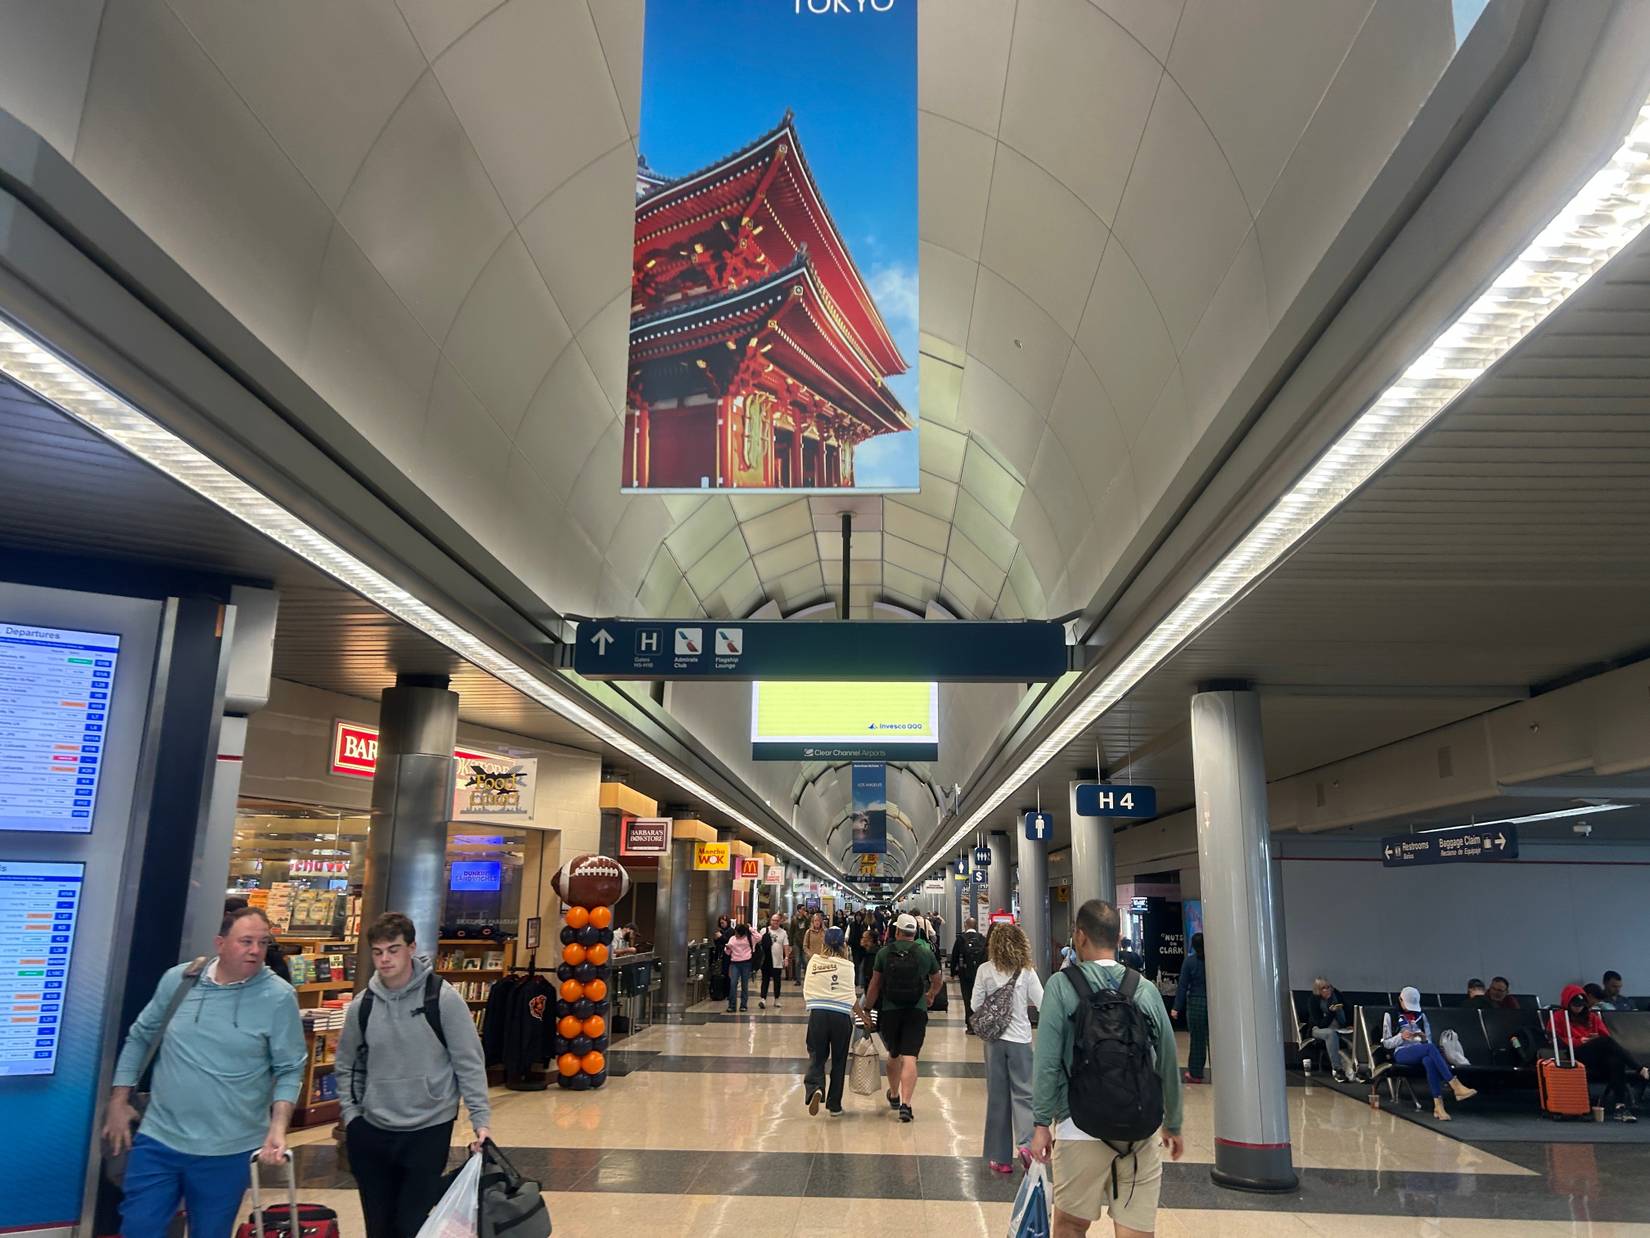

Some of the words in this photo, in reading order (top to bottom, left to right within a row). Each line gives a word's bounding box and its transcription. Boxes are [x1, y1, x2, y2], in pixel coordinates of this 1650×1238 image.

[5, 627, 61, 640] Departures
[641, 632, 657, 651] H
[862, 749, 886, 757] Airports
[474, 774, 516, 790] Food
[1100, 792, 1114, 809] H
[1120, 792, 1134, 809] 4
[1402, 841, 1429, 851] Restrooms
[1439, 838, 1463, 849] Baggage
[1465, 835, 1481, 845] Claim
[698, 856, 724, 865] WOK
